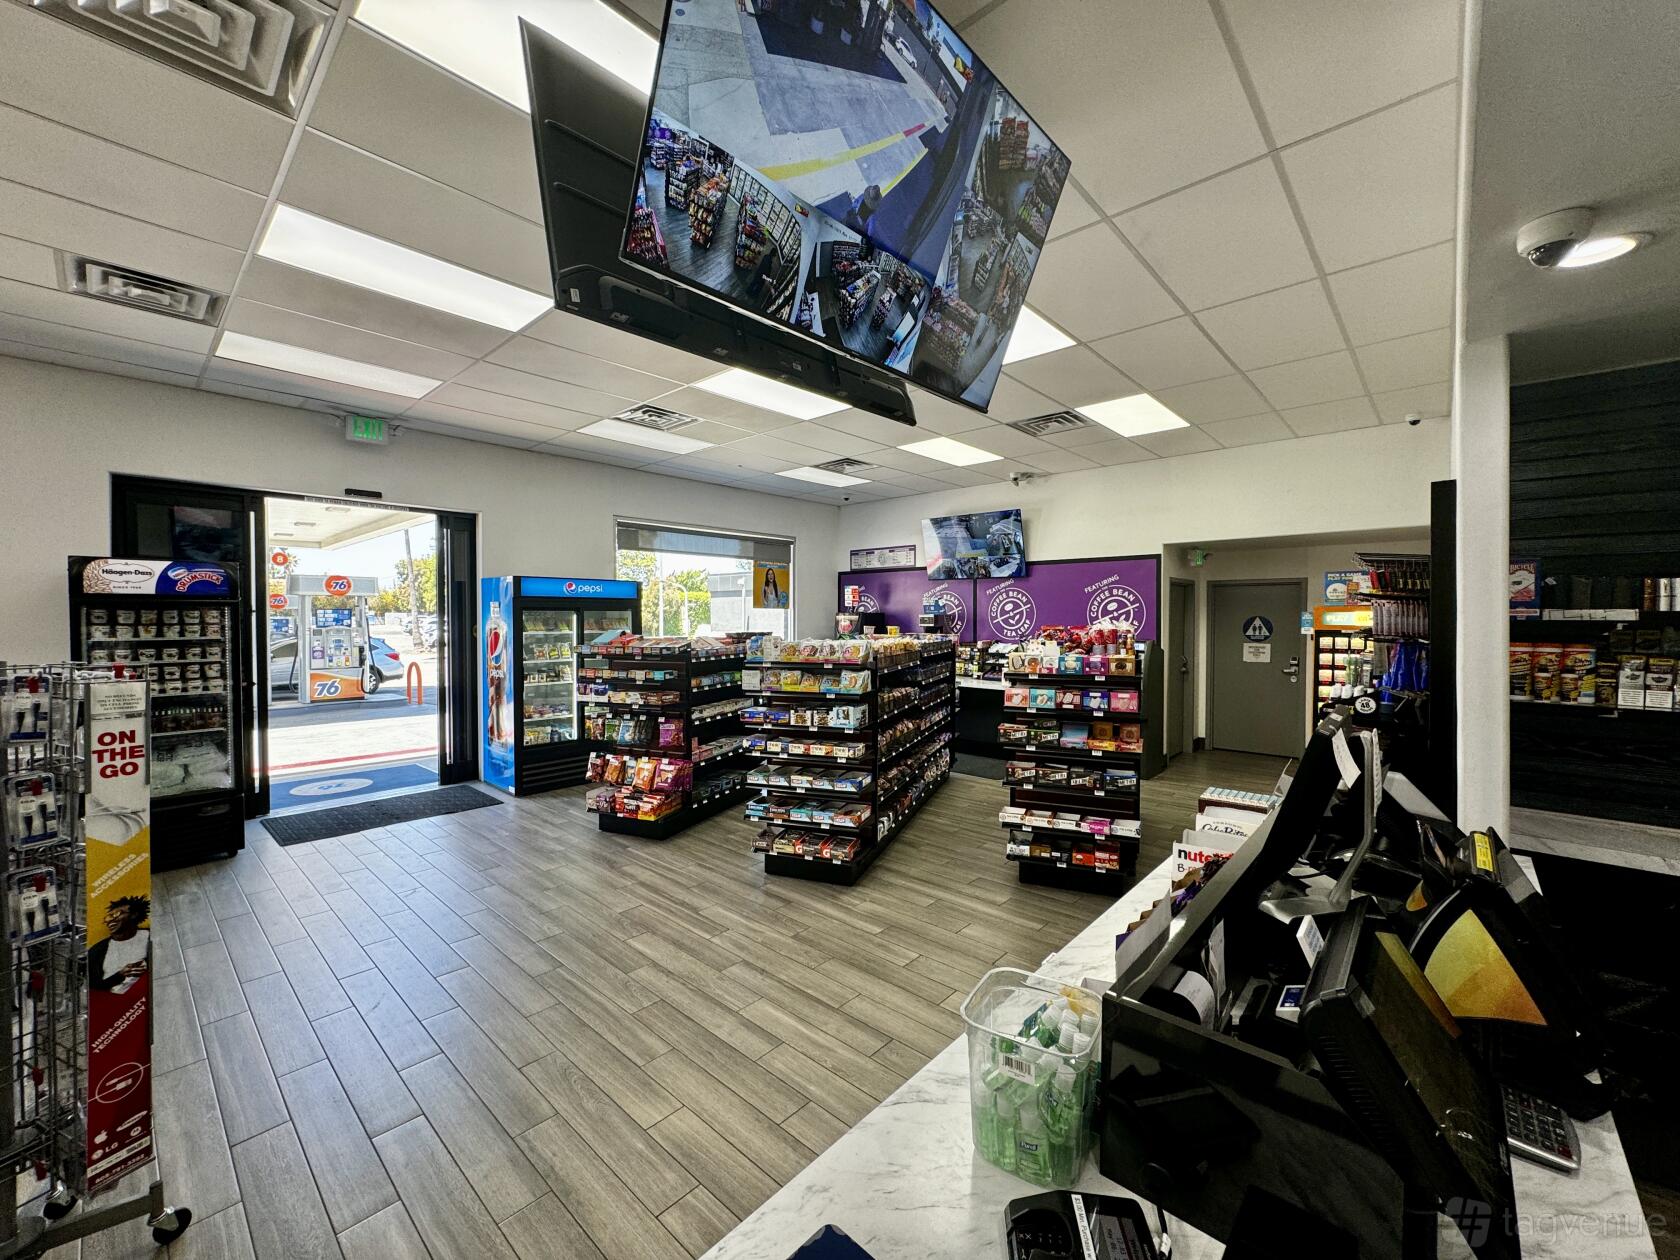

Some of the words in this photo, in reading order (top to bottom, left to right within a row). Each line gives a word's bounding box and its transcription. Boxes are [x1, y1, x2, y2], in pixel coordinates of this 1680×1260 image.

[176, 572, 223, 592] DRUMSTICK
[332, 580, 347, 590] 76
[578, 584, 604, 594] pepsi
[986, 578, 1015, 595] FEATURING
[1084, 574, 1120, 594] FEATURING
[943, 594, 960, 606] BEAN
[991, 592, 1008, 617] COFFEE
[1008, 591, 1028, 604] BEAN
[1090, 589, 1110, 617] COFFEE
[1112, 588, 1136, 602] BEAN
[1002, 628, 1017, 637] TEA
[1017, 618, 1031, 636] LEAF
[314, 679, 342, 698] 76
[98, 730, 136, 746] ON
[92, 744, 145, 763] THE
[100, 762, 139, 779] GO
[823, 849, 830, 858] G
[91, 853, 148, 898] ACCESSORIES
[92, 854, 136, 886] WIRELESS
[91, 996, 146, 1048] HIGH-QUALITY
[92, 1005, 146, 1053] TECHNOLOGY
[105, 1142, 118, 1152] LG
